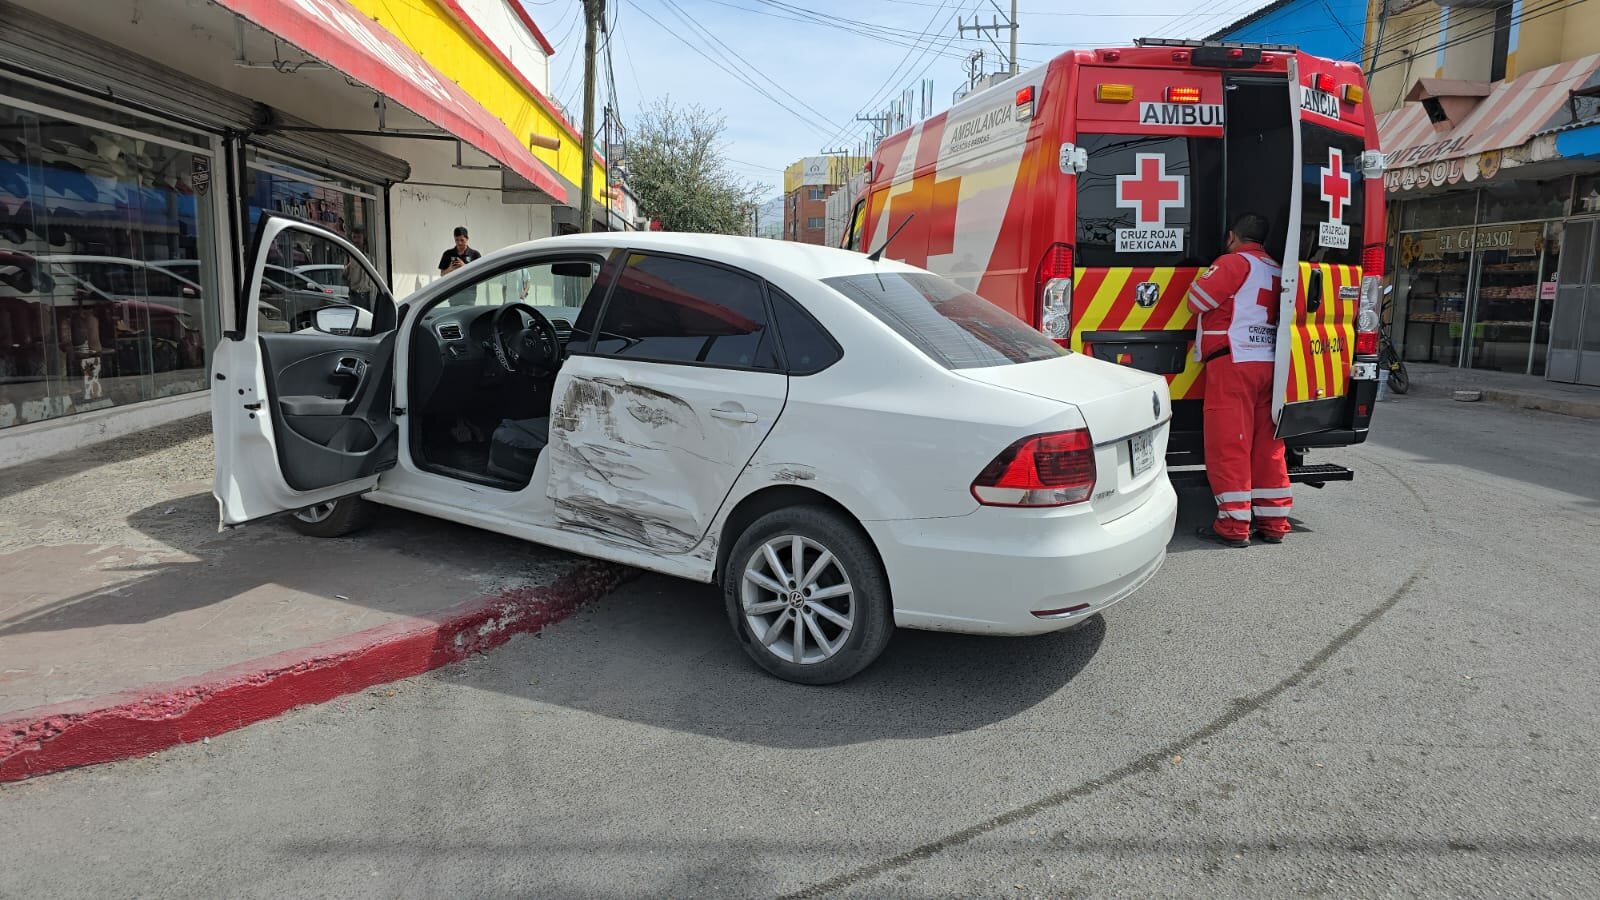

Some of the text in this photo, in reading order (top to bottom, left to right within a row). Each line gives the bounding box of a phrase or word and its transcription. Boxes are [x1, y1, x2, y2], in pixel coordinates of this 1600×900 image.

[1300, 88, 1339, 119] ANCIA
[950, 104, 1012, 144] AMBULANCIA
[1120, 230, 1177, 239] CRUZ ROJA
[1120, 240, 1177, 249] MEXICANA
[1439, 235, 1453, 249] EL
[1248, 326, 1266, 335] CRUZ
[1310, 337, 1345, 355] COAH-202
